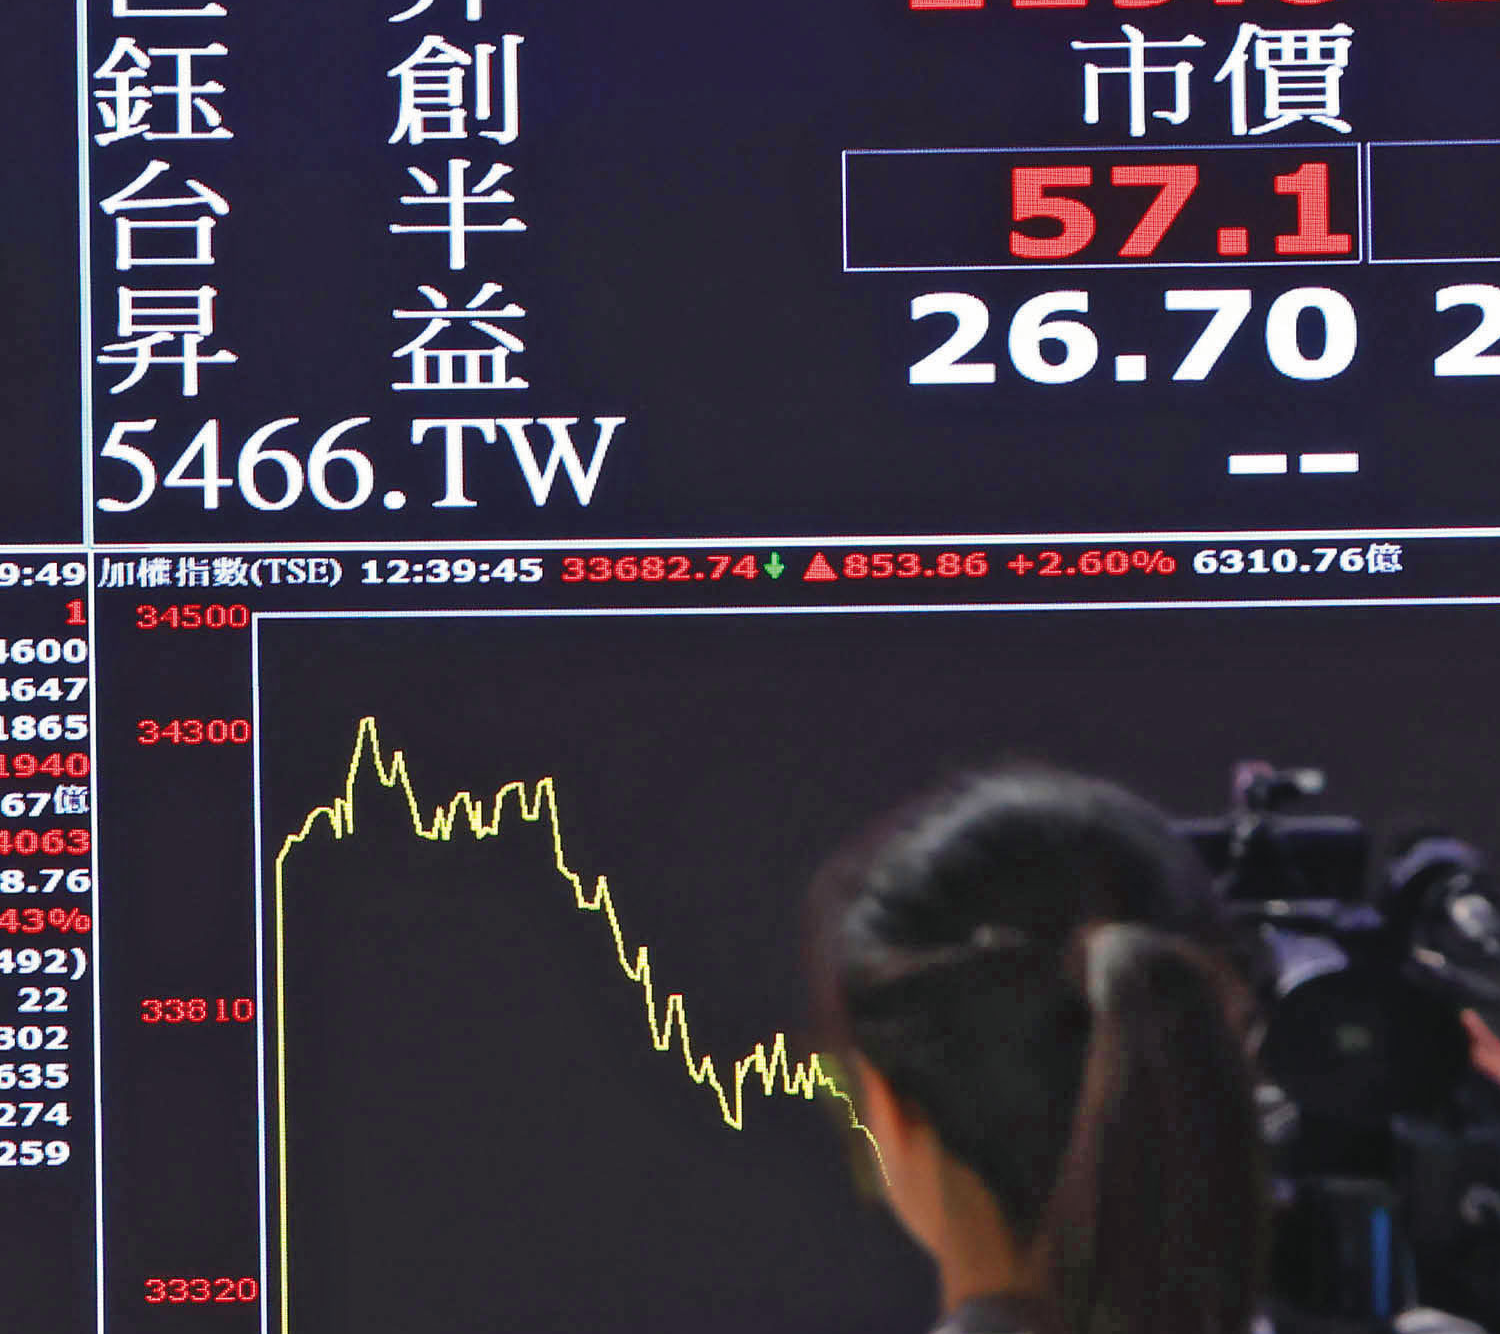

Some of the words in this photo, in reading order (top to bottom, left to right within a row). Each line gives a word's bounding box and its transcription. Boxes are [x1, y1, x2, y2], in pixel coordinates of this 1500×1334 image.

[1071, 22, 1355, 137] 市價
[96, 416, 626, 516] 5466.TW
[361, 557, 544, 584] 12:39:45
[561, 554, 760, 583] 33682.74
[842, 551, 989, 579] 853.86
[1007, 549, 1177, 577] +2.60%
[65, 598, 87, 626] 1
[135, 604, 250, 630] 34500
[137, 719, 252, 745] 34300
[141, 997, 255, 1024] 33810
[143, 1276, 259, 1304] 33320
